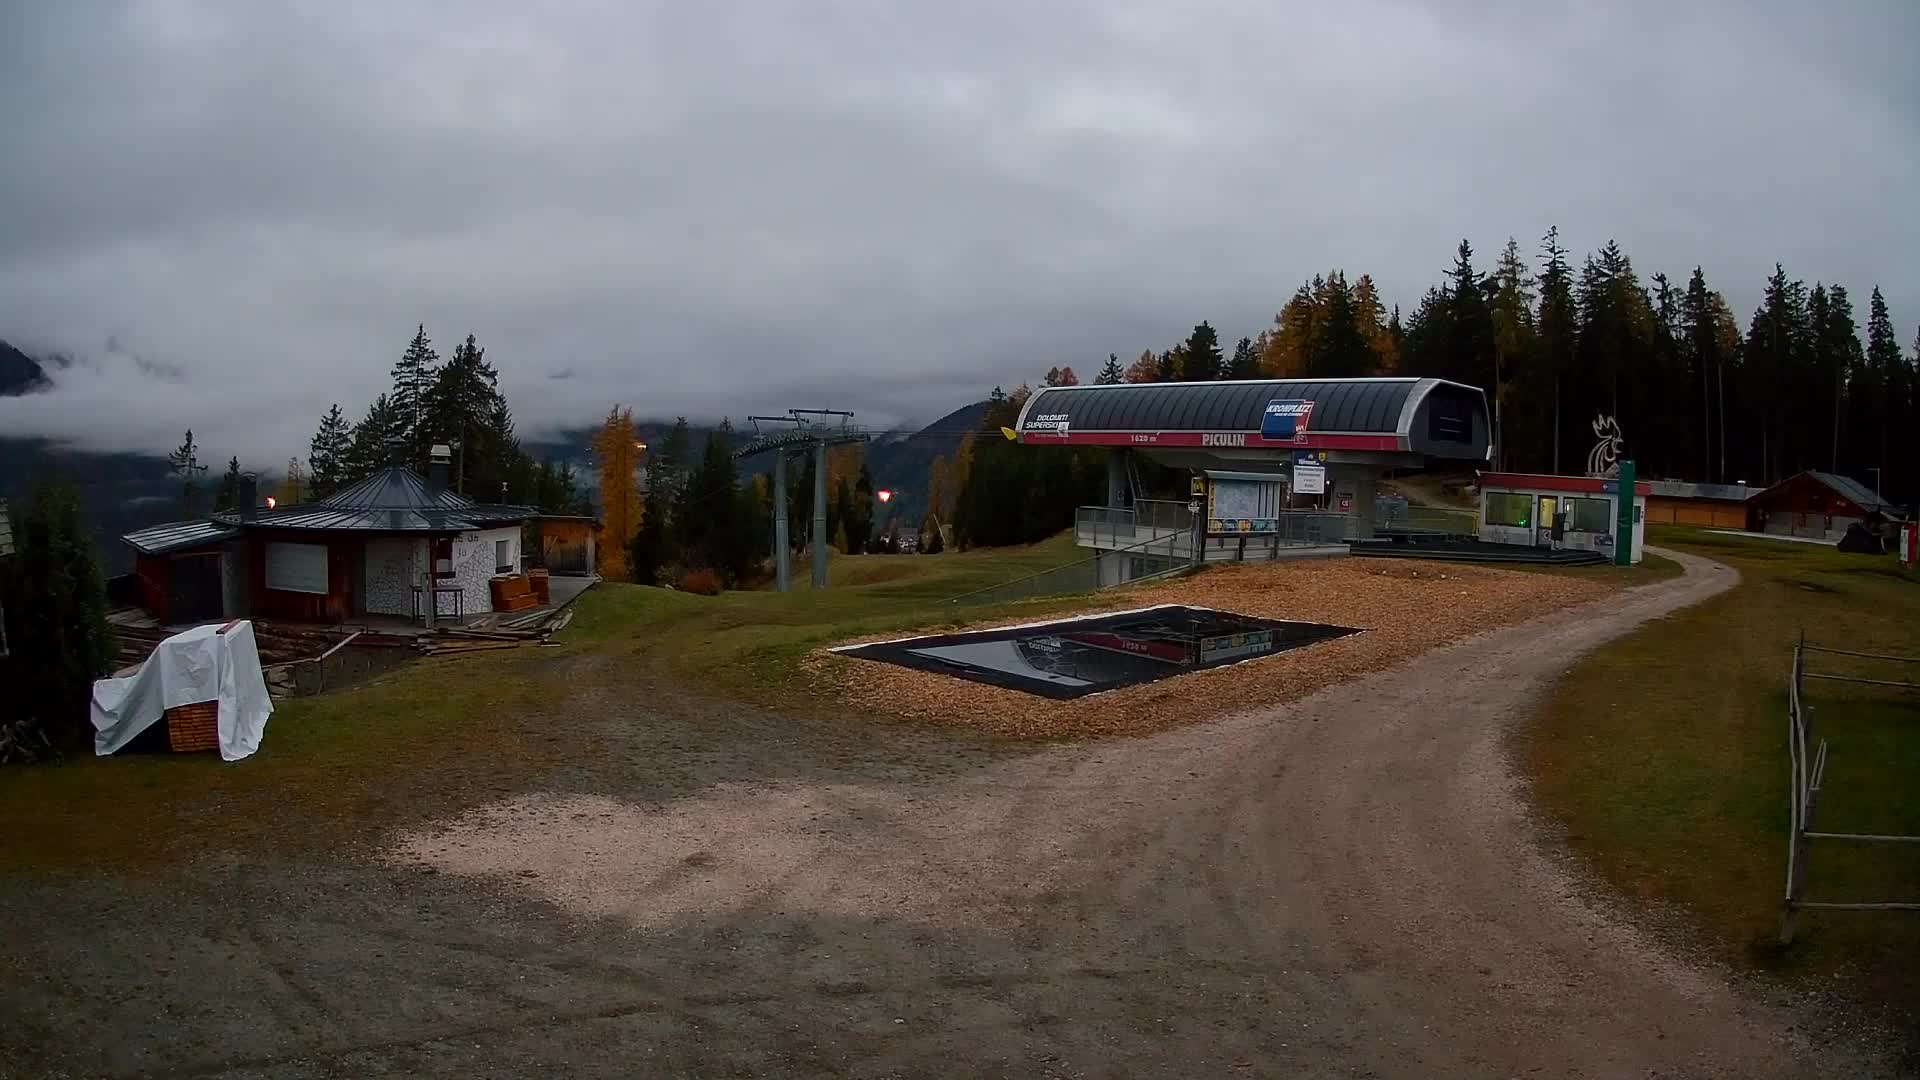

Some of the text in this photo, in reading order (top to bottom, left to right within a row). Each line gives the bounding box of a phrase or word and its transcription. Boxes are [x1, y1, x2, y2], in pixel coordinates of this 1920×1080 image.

[1266, 404, 1312, 413] KRONPLATZ
[1026, 421, 1059, 429] SUPERSKI
[1202, 433, 1245, 447] PICULIN
